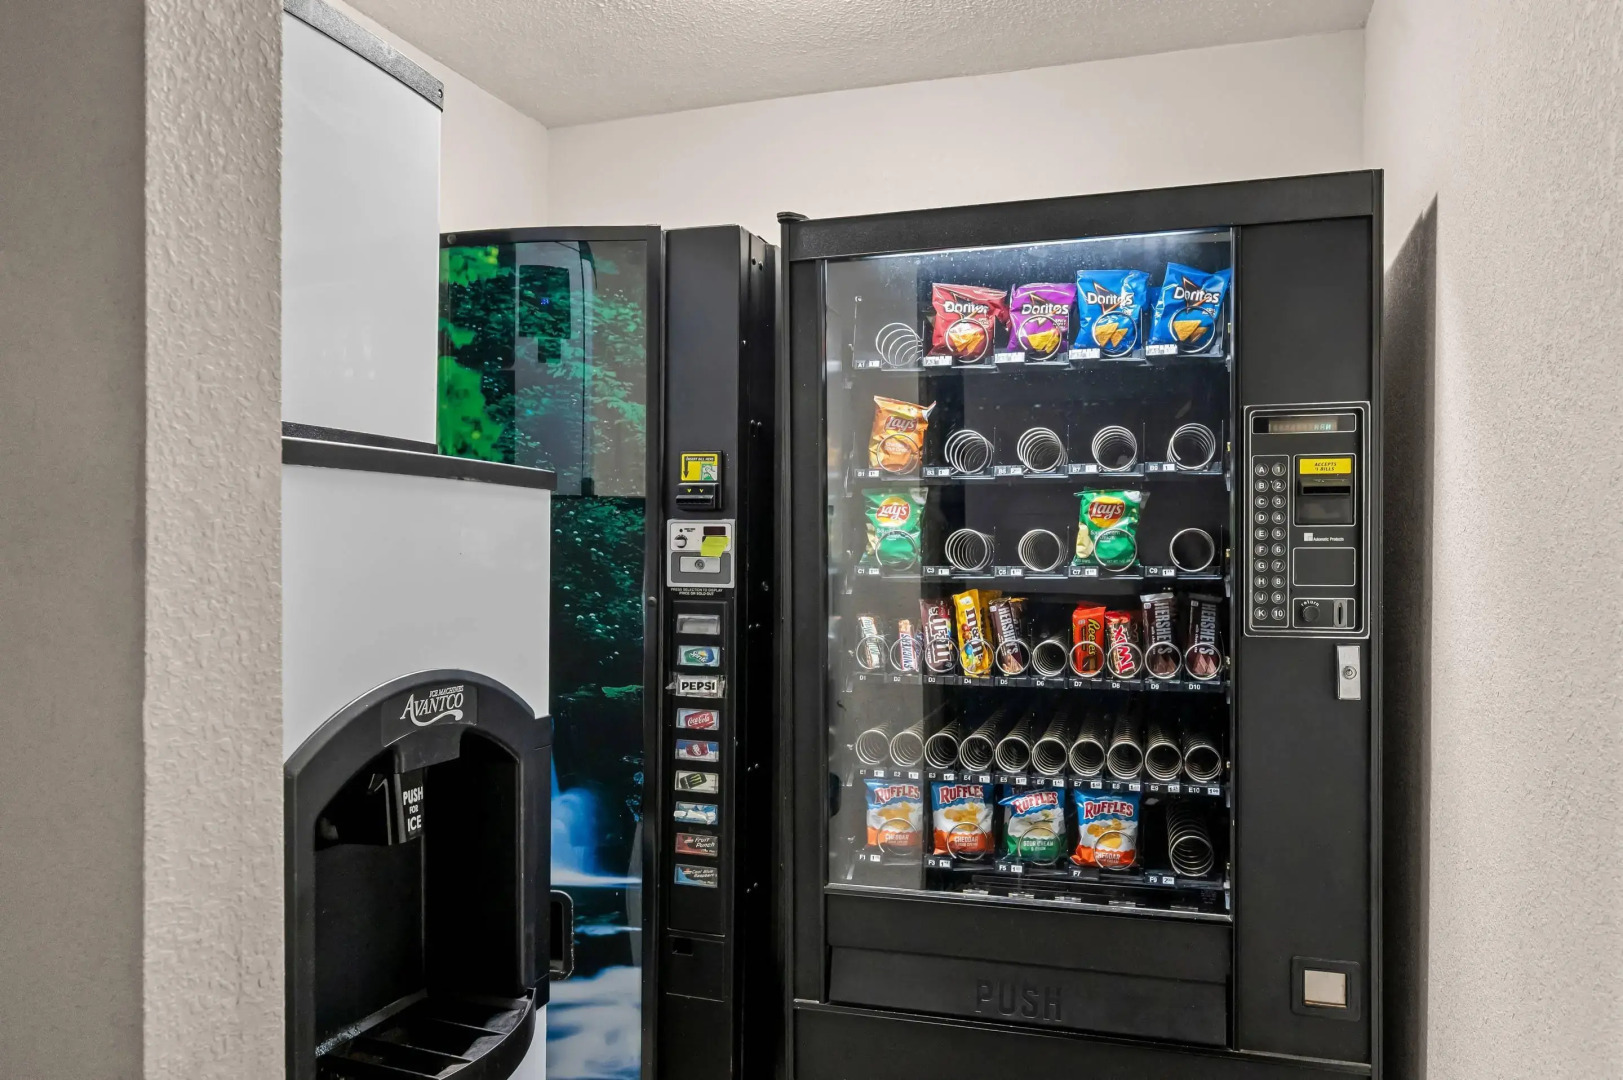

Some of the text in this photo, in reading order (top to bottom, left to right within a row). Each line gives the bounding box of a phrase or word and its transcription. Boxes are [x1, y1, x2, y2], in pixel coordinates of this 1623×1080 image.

[1173, 286, 1221, 304] Doritos
[1021, 303, 1069, 315] Doritos
[1091, 502, 1124, 520] Lay's
[900, 633, 914, 671] SNICKERS
[429, 684, 465, 698] ICE MACHINES
[681, 681, 716, 691] PEPSI
[400, 693, 464, 727] AVANTCO
[402, 786, 424, 806] PUSH
[874, 784, 921, 804] RUFFLES
[939, 784, 984, 804] RUFFLES
[1011, 791, 1059, 814] RUFFLES
[409, 804, 419, 814] FOR
[1084, 800, 1134, 819] RUFFLES
[408, 814, 422, 832] ICE
[976, 978, 1063, 1022] PUSH
